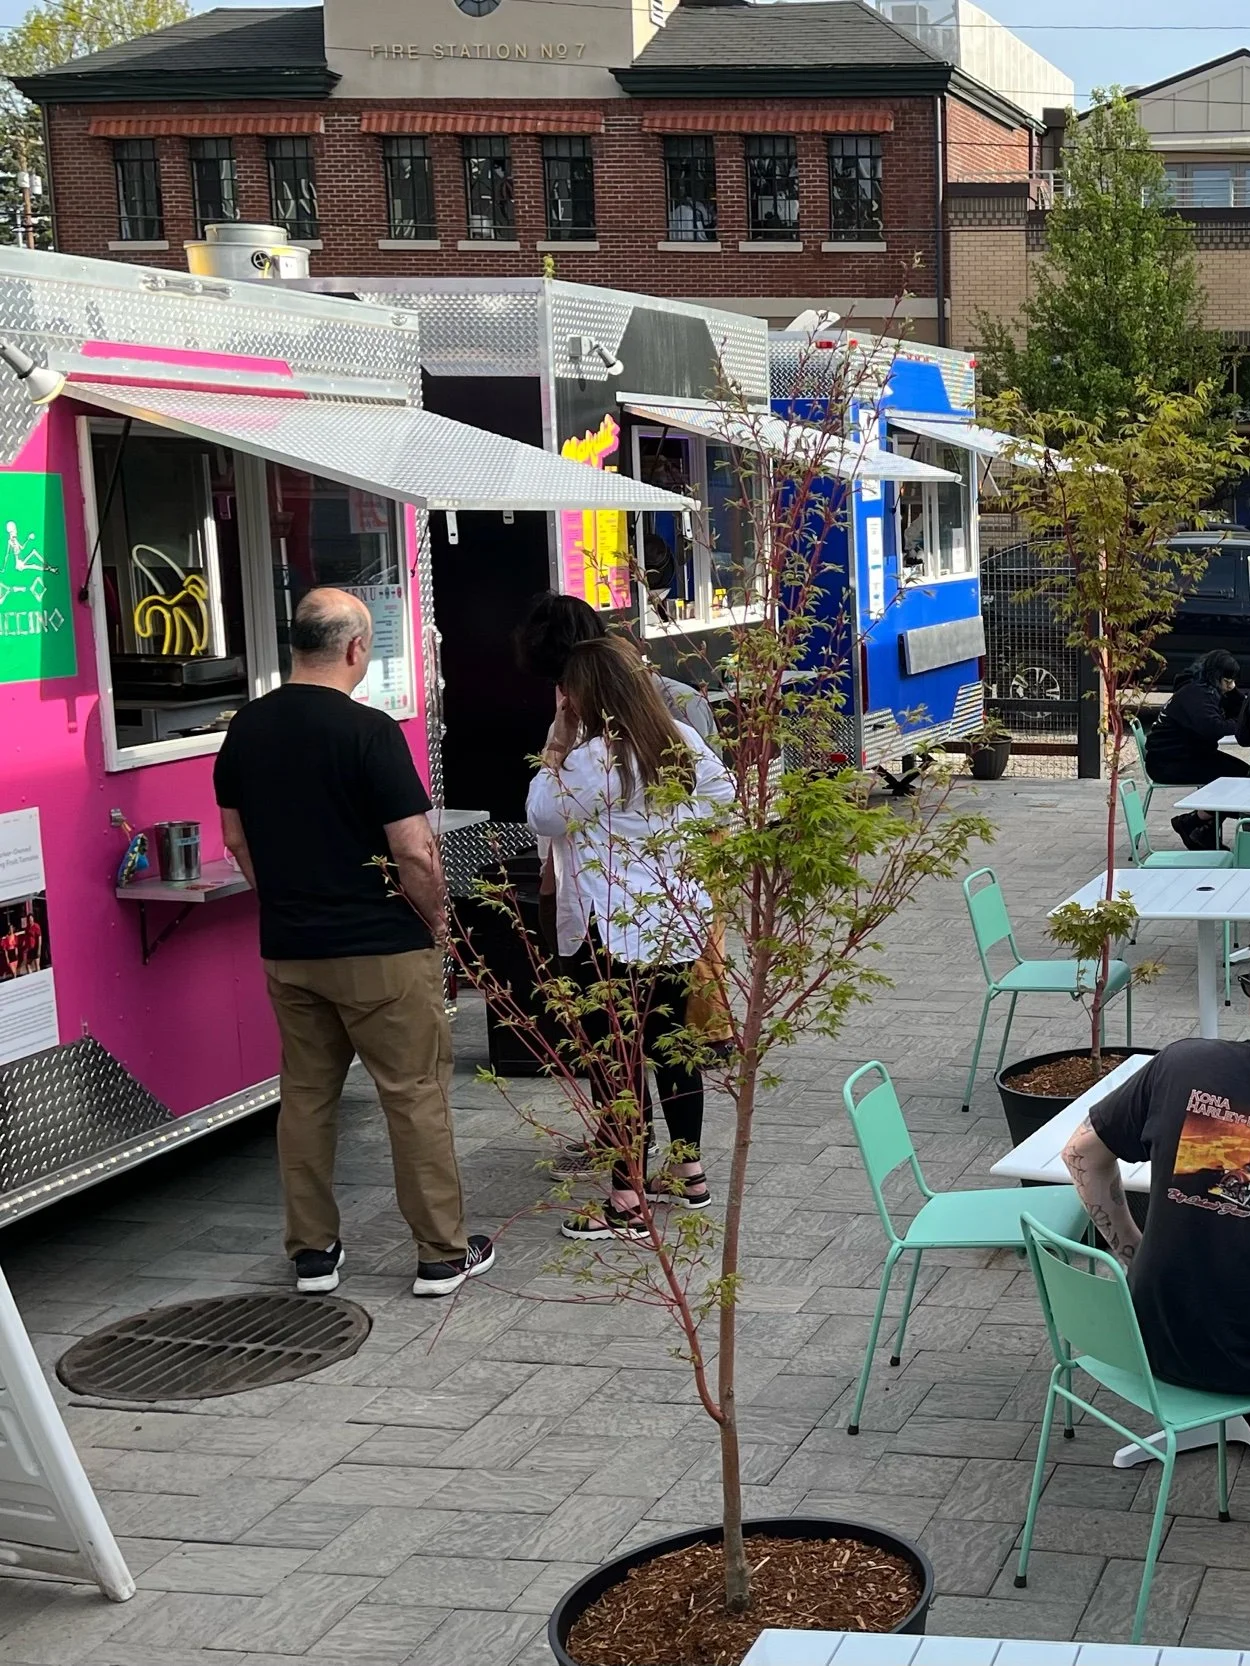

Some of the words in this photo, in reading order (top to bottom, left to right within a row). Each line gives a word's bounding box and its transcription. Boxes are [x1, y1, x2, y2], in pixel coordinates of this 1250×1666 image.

[369, 44, 419, 60] FIRE
[432, 43, 528, 60] STATION
[576, 43, 587, 59] 7
[340, 587, 376, 601] ENU
[1190, 1088, 1231, 1110] KONA
